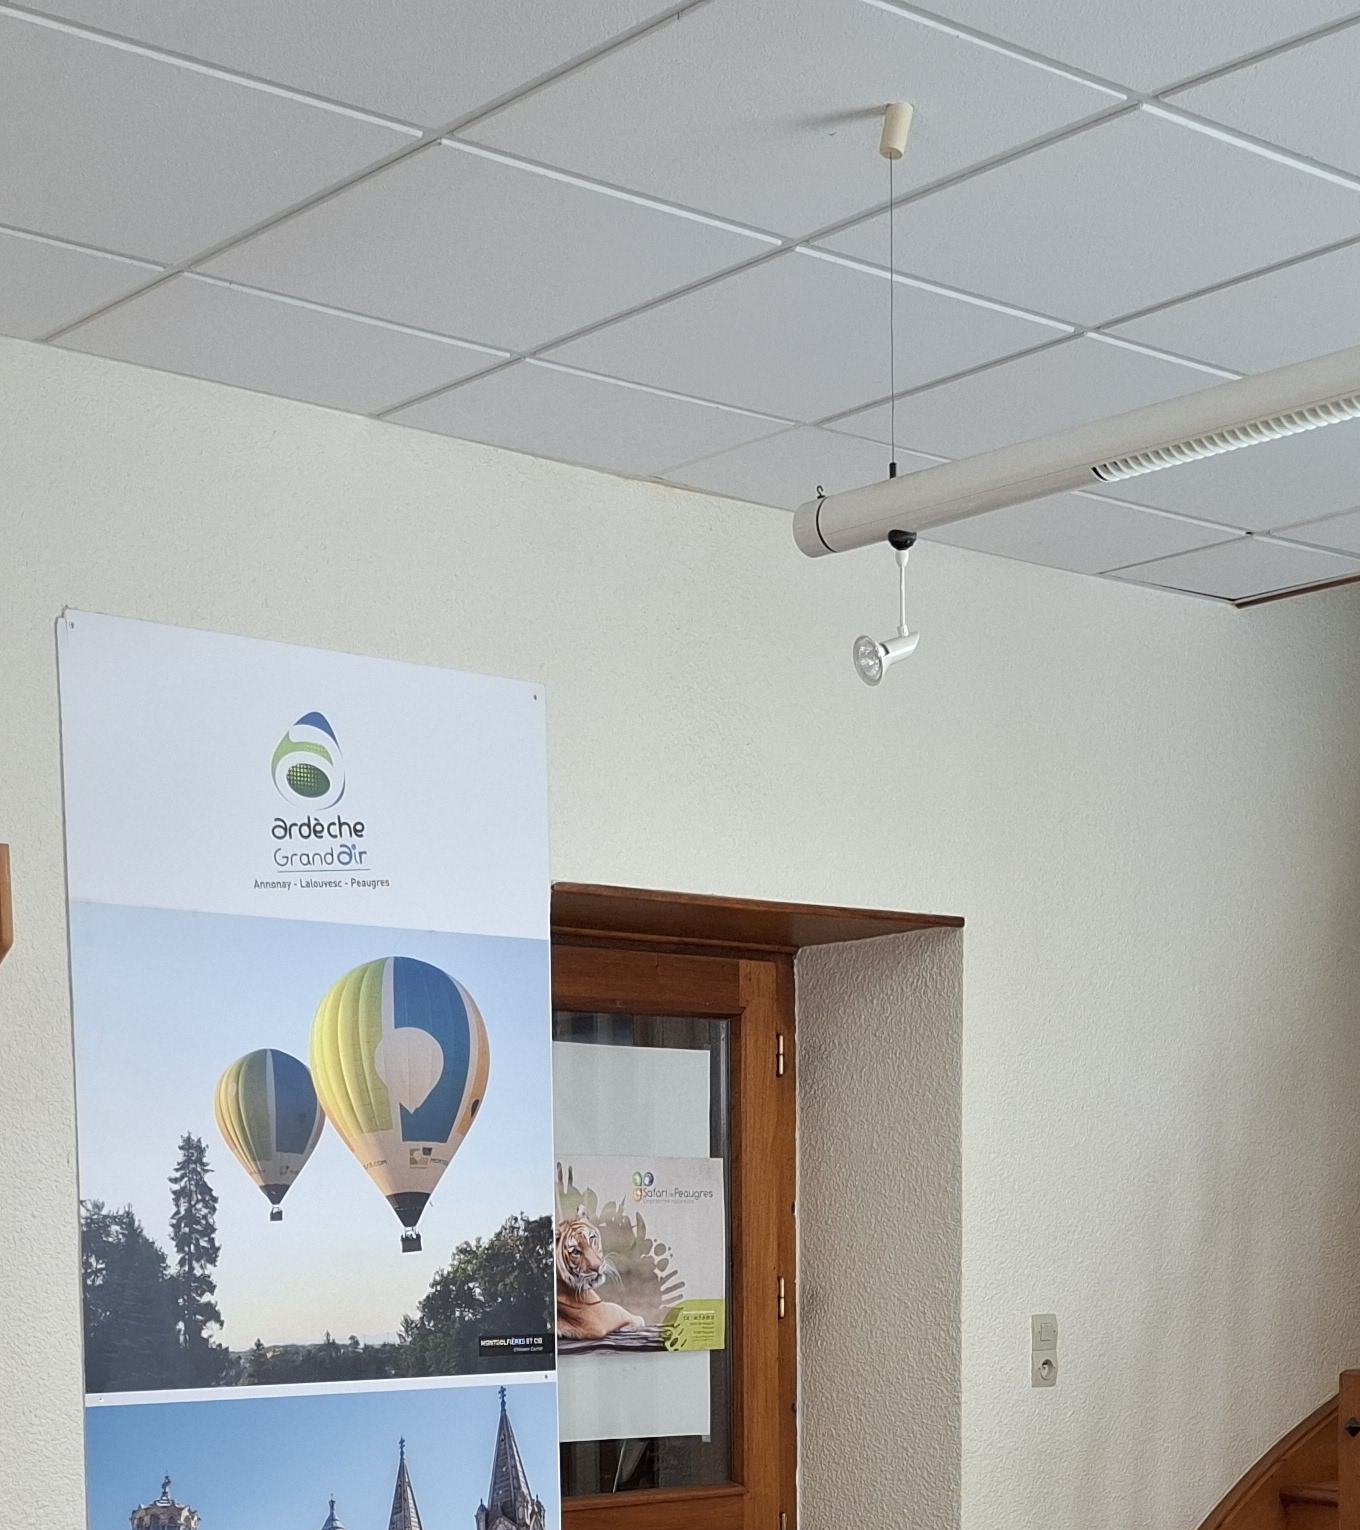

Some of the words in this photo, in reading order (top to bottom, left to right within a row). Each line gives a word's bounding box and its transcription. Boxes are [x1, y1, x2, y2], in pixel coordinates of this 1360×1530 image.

[271, 815, 365, 840] ardèche
[253, 879, 292, 891] Annonay
[299, 878, 343, 889] Lalouvesc
[350, 878, 391, 890] Peaugres
[642, 1187, 668, 1199] Safari
[674, 1187, 714, 1201] Peaugres
